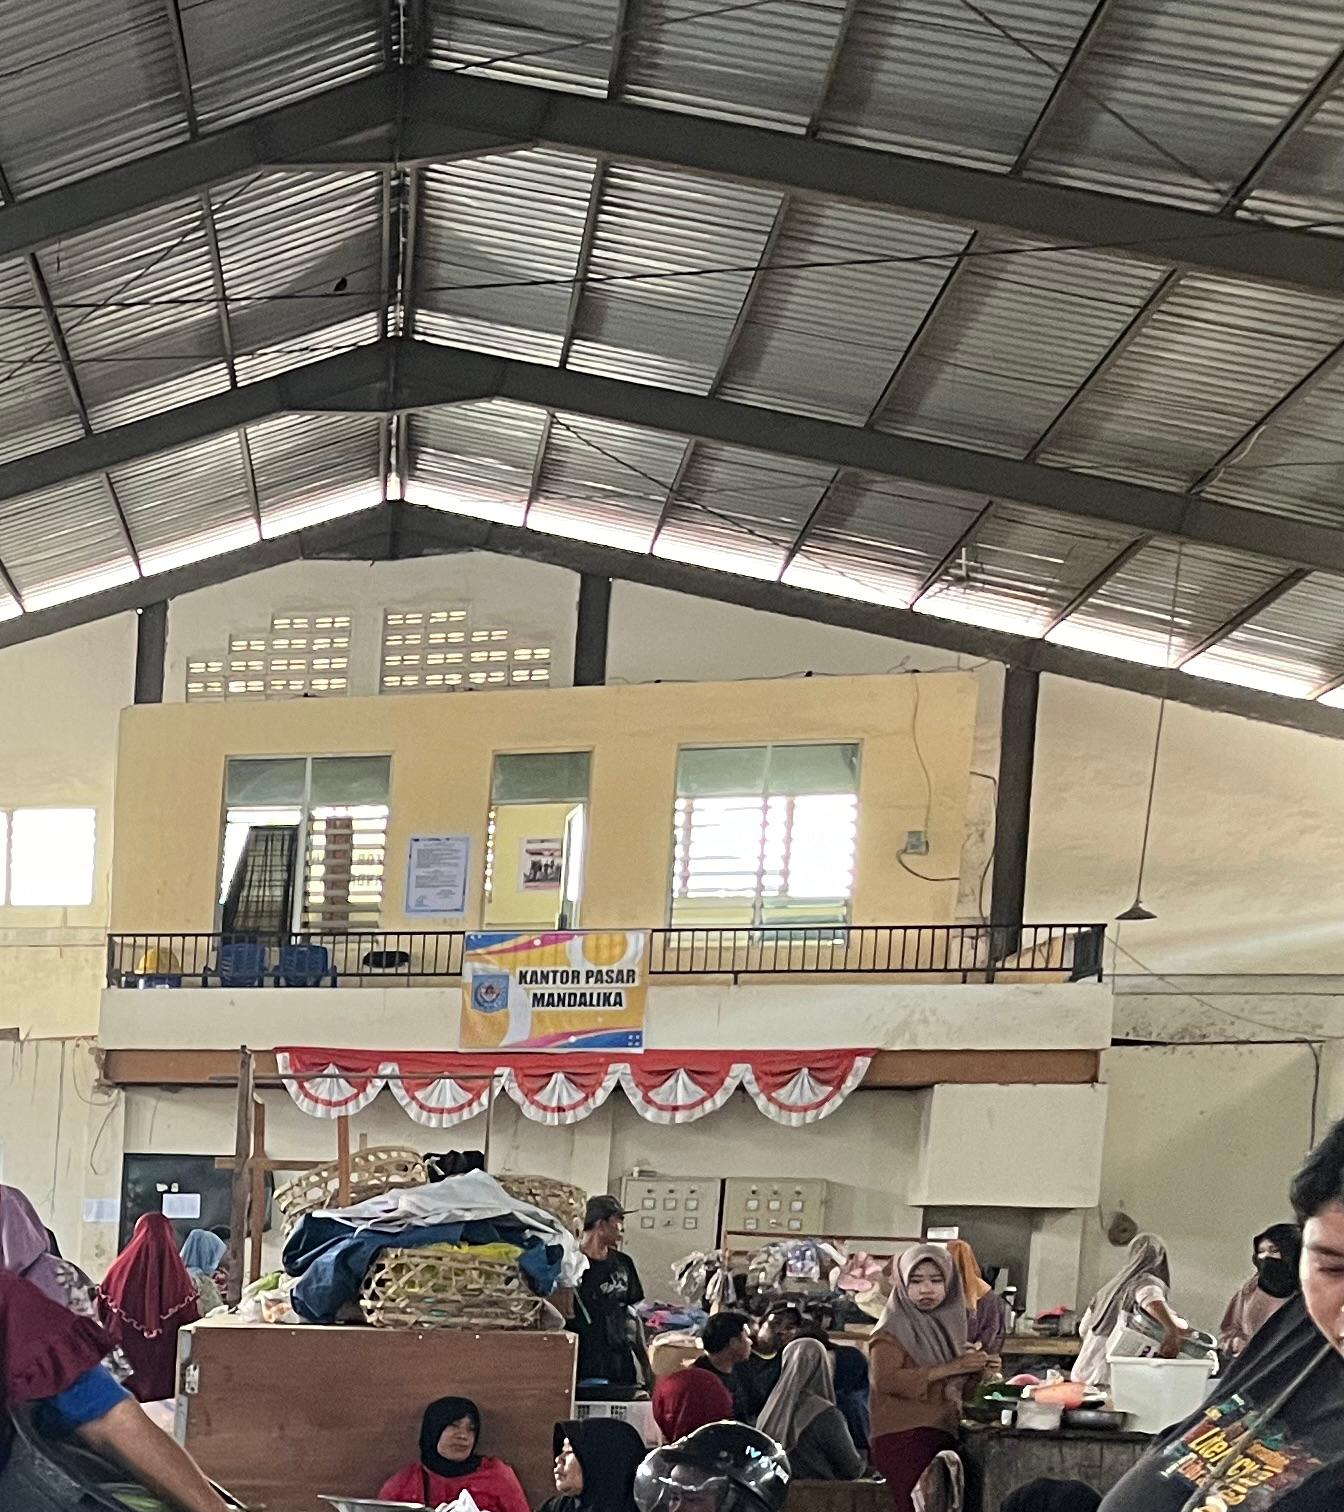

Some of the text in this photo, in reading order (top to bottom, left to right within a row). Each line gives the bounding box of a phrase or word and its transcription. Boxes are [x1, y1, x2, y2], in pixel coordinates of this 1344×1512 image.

[518, 968, 637, 985] KANTOR PASAR
[531, 991, 624, 1008] MANDALIKA
[1188, 1426, 1261, 1484] Litercy
